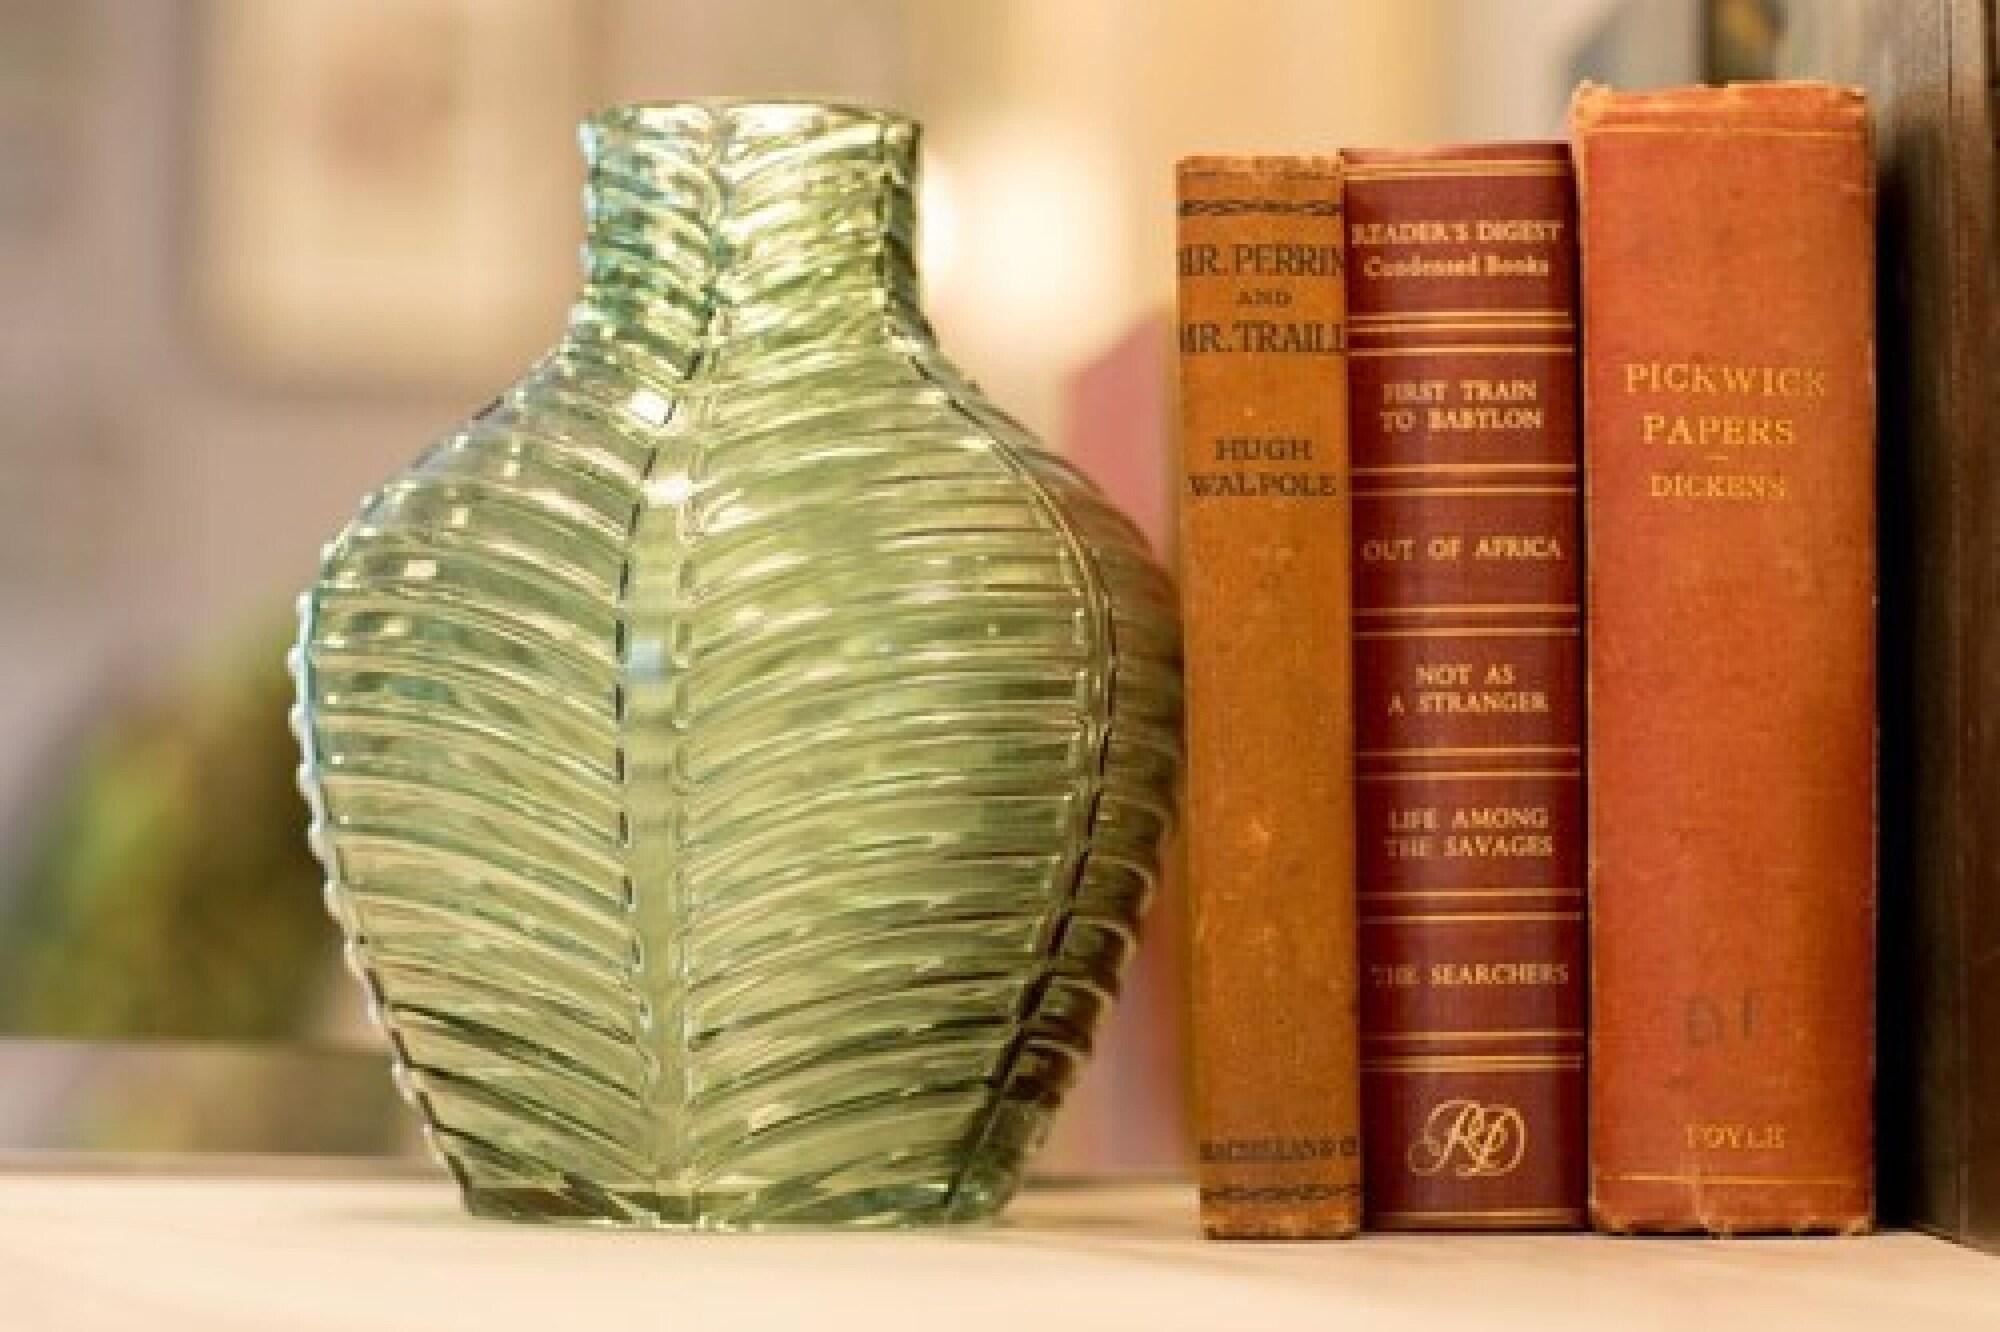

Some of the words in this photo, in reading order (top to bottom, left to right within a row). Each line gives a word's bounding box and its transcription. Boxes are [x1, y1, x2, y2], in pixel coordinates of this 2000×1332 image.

[1352, 223, 1469, 245] READER'S
[1476, 219, 1564, 242] DIGEST
[1363, 252, 1479, 278] Condensed
[1484, 254, 1551, 277] Books
[1235, 288, 1293, 308] AND
[1381, 380, 1450, 405] FIRST
[1459, 379, 1538, 402] TRAIN
[1623, 361, 1826, 397] PICKWICK
[1379, 409, 1417, 433] TO
[1425, 407, 1545, 432] BABYLON
[1641, 412, 1797, 448] PAPERS
[1214, 439, 1313, 461] HUGH
[1187, 472, 1338, 497] WALPOLE
[1649, 473, 1789, 499] DICKENS
[1361, 539, 1416, 562] OUT
[1426, 537, 1464, 561] OF
[1472, 536, 1564, 561] AFRICA
[1414, 663, 1472, 686] NOT
[1483, 663, 1517, 686] AS
[1387, 694, 1406, 717] A
[1416, 691, 1551, 714] STRANGER
[1388, 808, 1440, 832] LIFE
[1450, 806, 1551, 831] AMONG
[1383, 837, 1437, 861] THE
[1443, 835, 1557, 858] SAVAGES
[1369, 964, 1422, 988] THE
[1428, 962, 1571, 986] SEARCHERS
